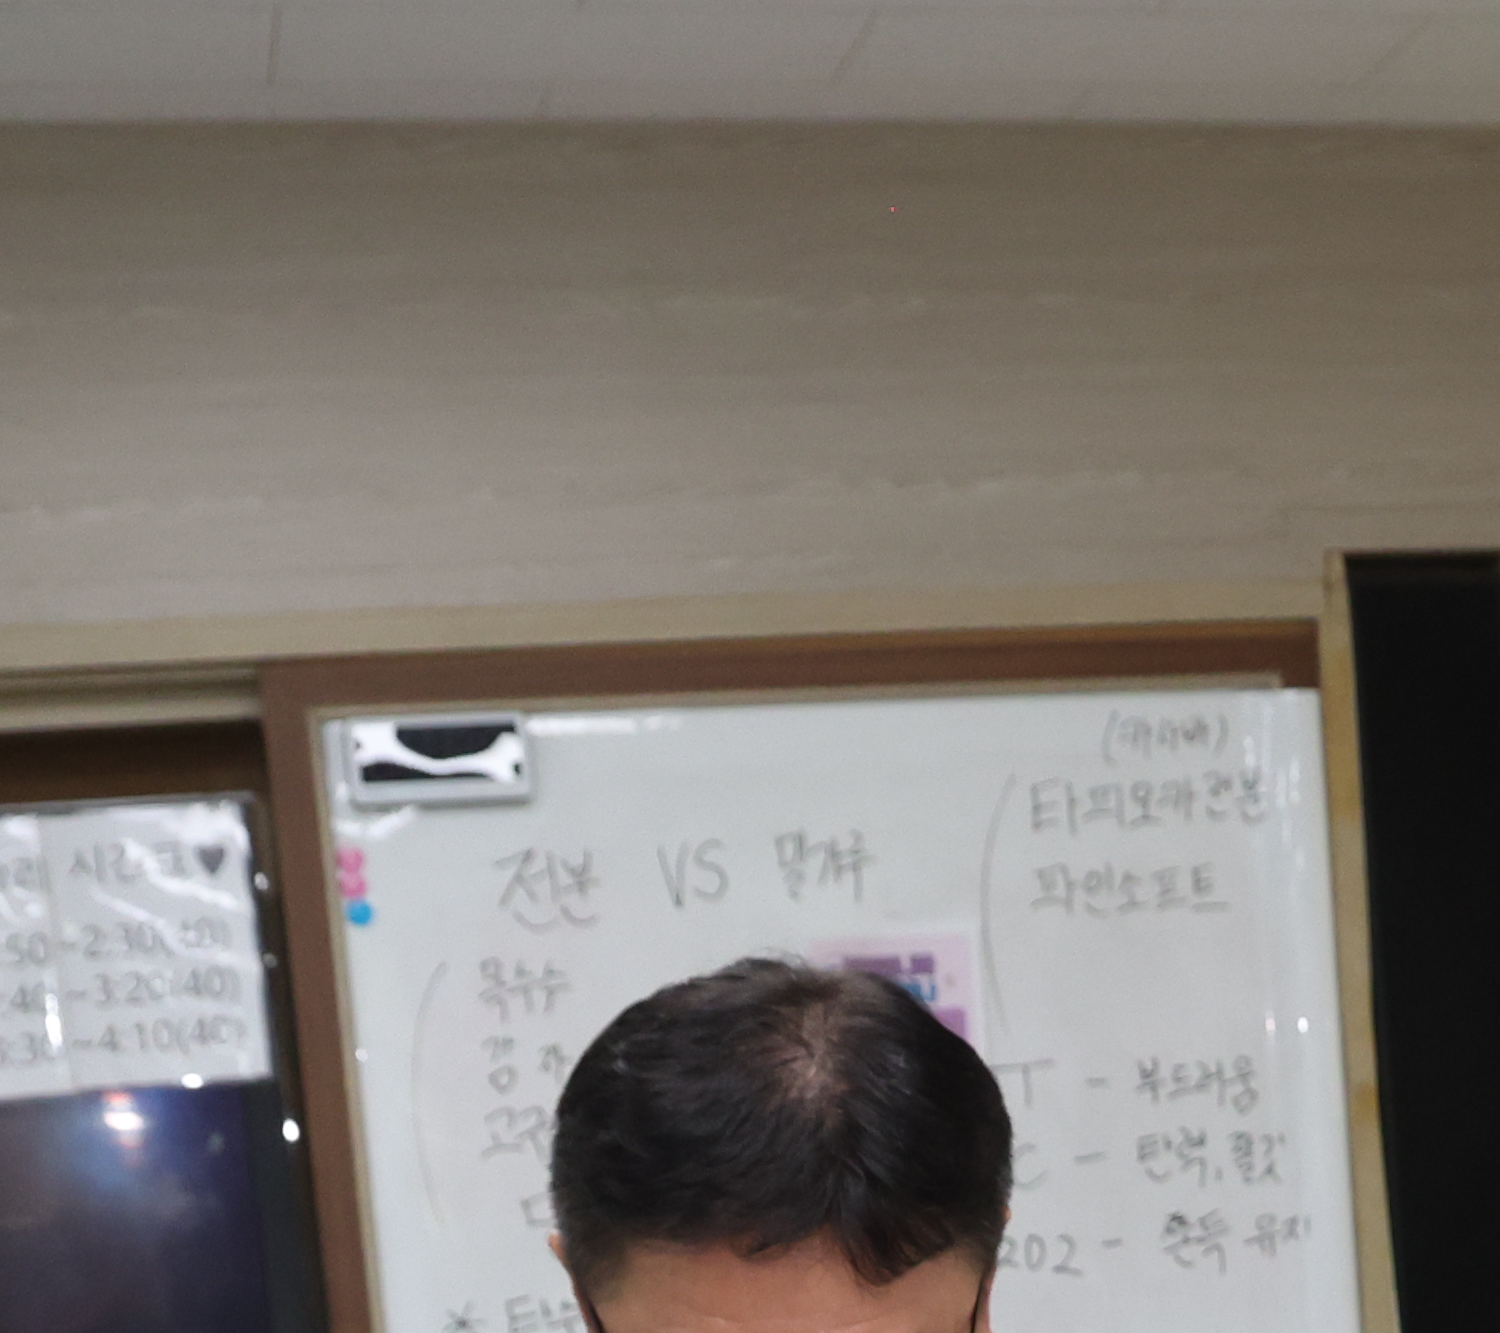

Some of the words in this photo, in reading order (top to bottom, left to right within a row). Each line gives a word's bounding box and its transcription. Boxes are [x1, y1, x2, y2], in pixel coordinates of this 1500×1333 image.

[494, 846, 599, 934] 전분
[656, 837, 730, 908] VS
[478, 956, 571, 1023] 옥수수
[478, 1105, 557, 1164] 고구
